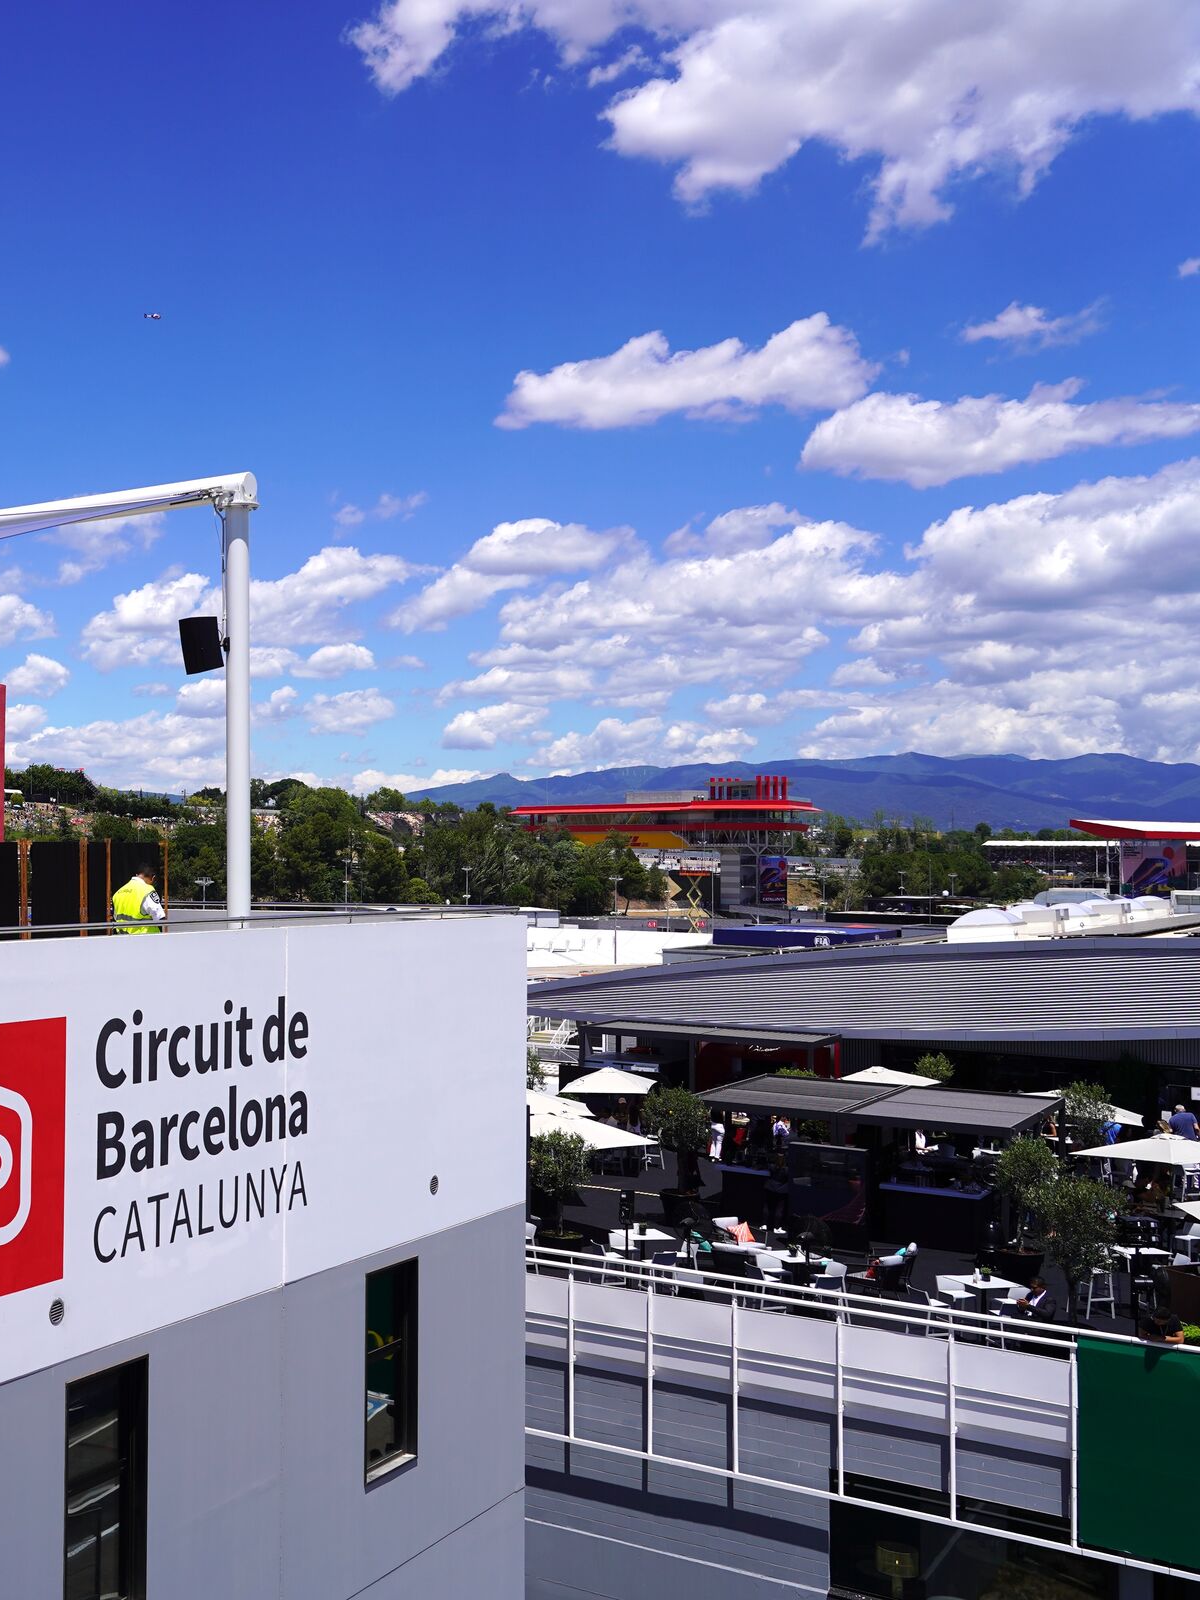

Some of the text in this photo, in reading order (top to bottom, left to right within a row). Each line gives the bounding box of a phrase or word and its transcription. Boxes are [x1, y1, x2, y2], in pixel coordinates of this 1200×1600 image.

[814, 936, 829, 947] FIA
[96, 995, 309, 1089] Circuit de
[97, 1085, 308, 1180] Barcelona
[93, 1161, 308, 1263] CATALUNYA
